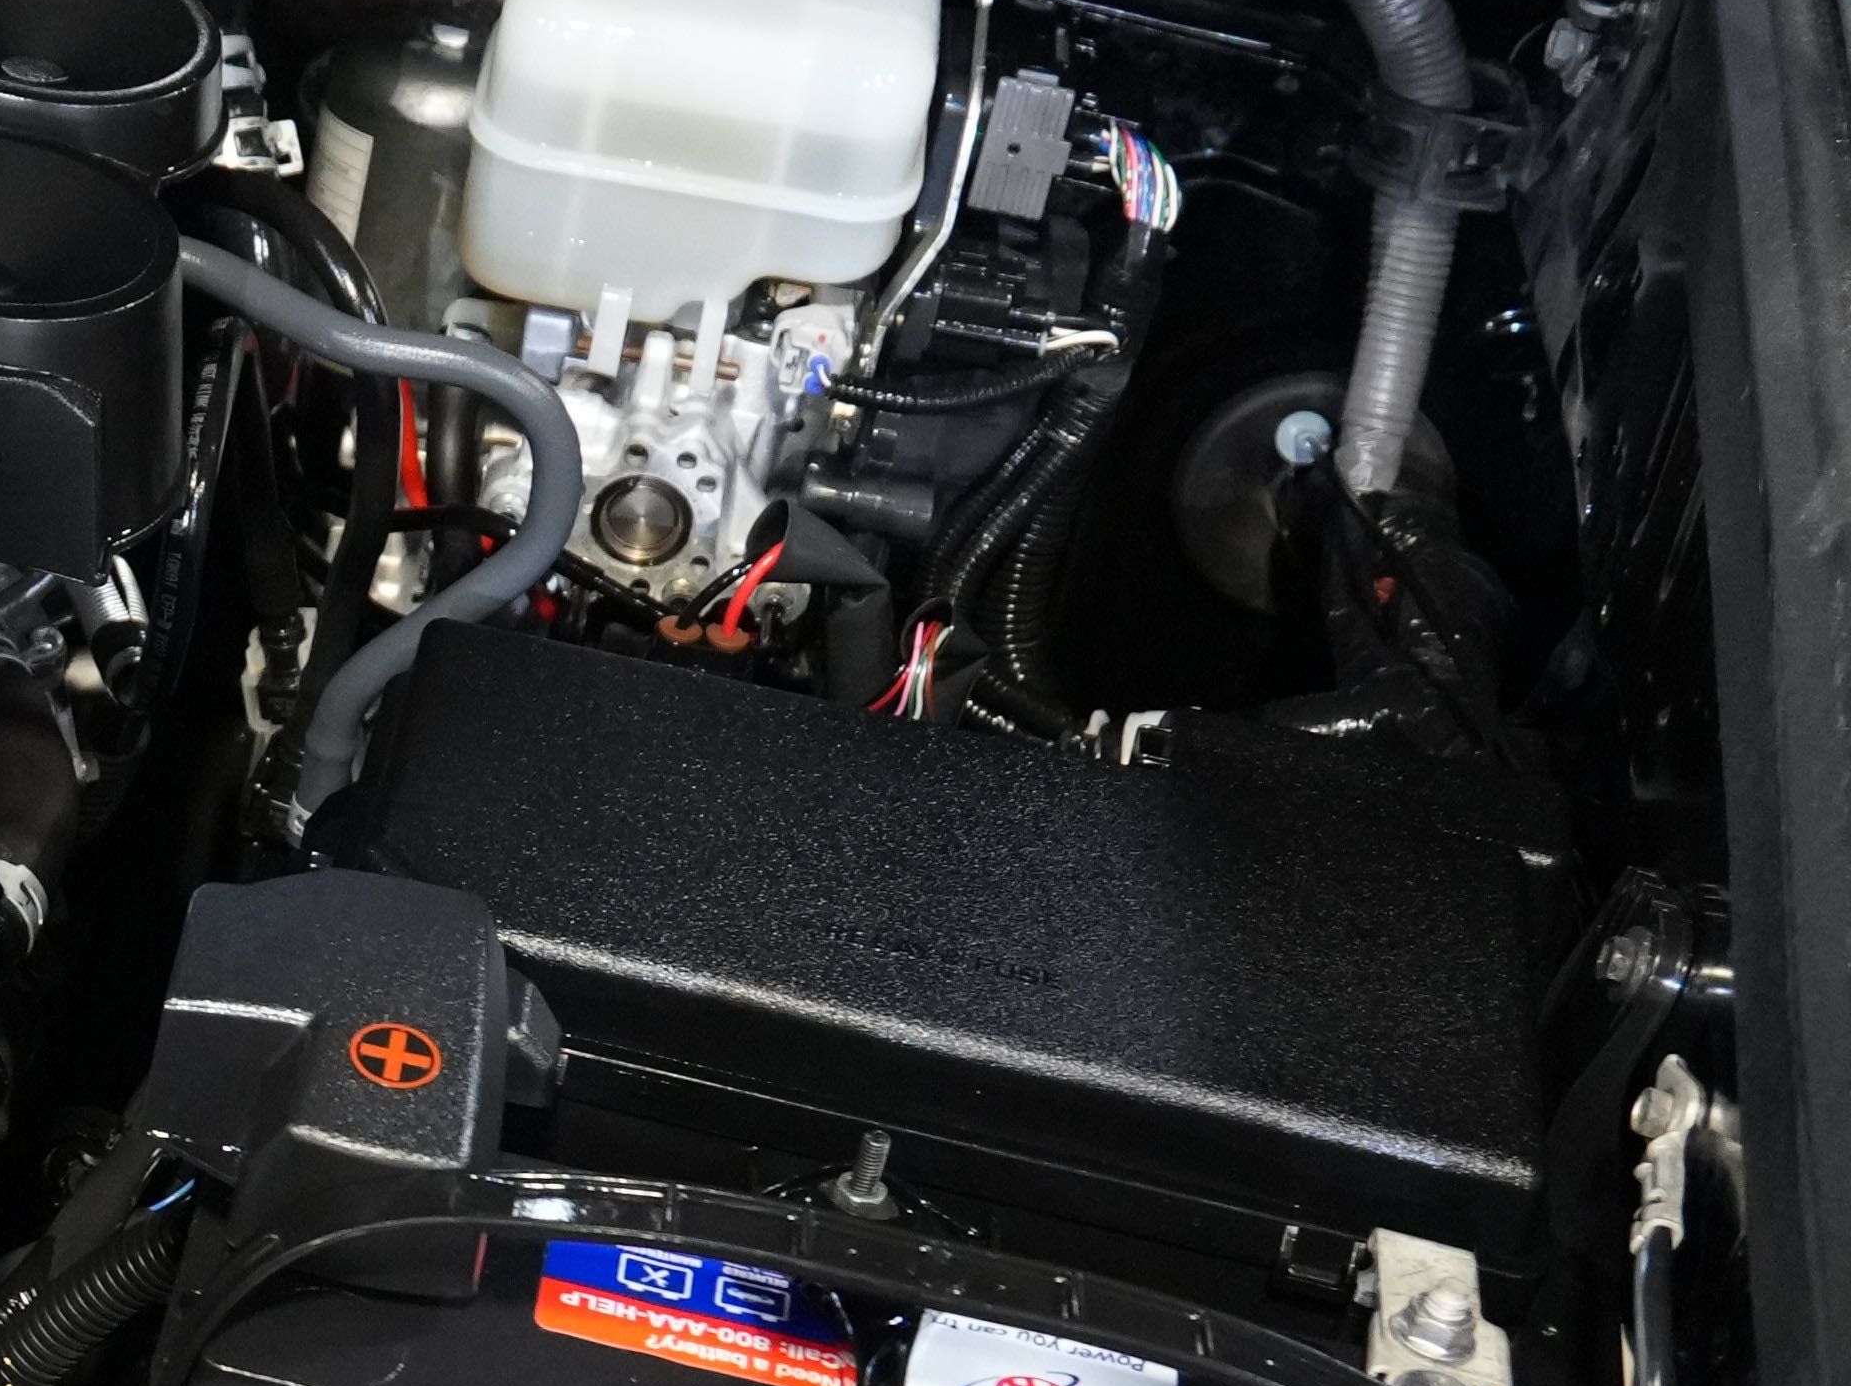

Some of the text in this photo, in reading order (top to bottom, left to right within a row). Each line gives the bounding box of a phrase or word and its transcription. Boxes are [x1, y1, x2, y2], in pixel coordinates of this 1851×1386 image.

[559, 1290, 842, 1370] Call: 800-AAA-HELP
[969, 1321, 1007, 1338] can
[1017, 1329, 1060, 1353] you
[645, 1334, 748, 1370] battery?
[753, 1357, 769, 1373] a
[1068, 1345, 1146, 1373] Power
